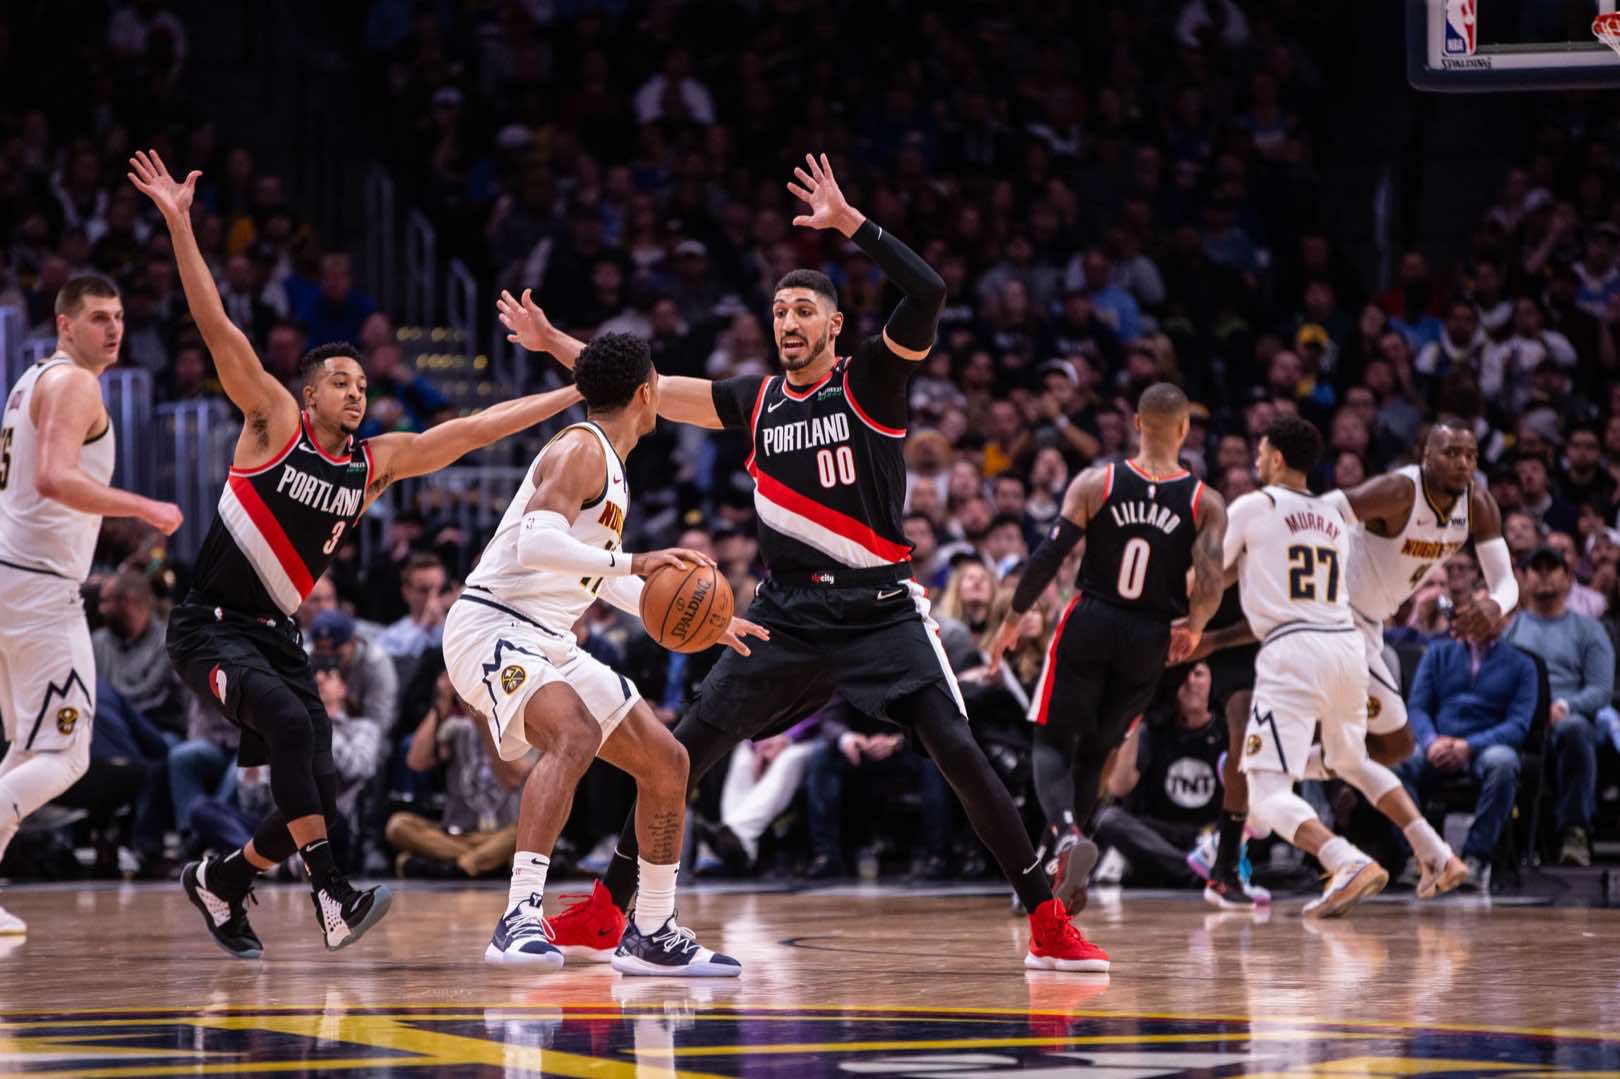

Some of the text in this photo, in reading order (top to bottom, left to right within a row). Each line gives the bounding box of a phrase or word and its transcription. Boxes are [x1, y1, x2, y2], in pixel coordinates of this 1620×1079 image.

[762, 412, 850, 457] PORTLAND
[816, 445, 856, 489] 00
[322, 520, 346, 555] 3
[1110, 501, 1181, 535] LILLARD
[1284, 512, 1341, 541] MURRAY
[1117, 537, 1151, 600] 0
[1288, 543, 1341, 602] 27
[671, 578, 712, 641] SPALDING
[1171, 775, 1212, 796] TNT
